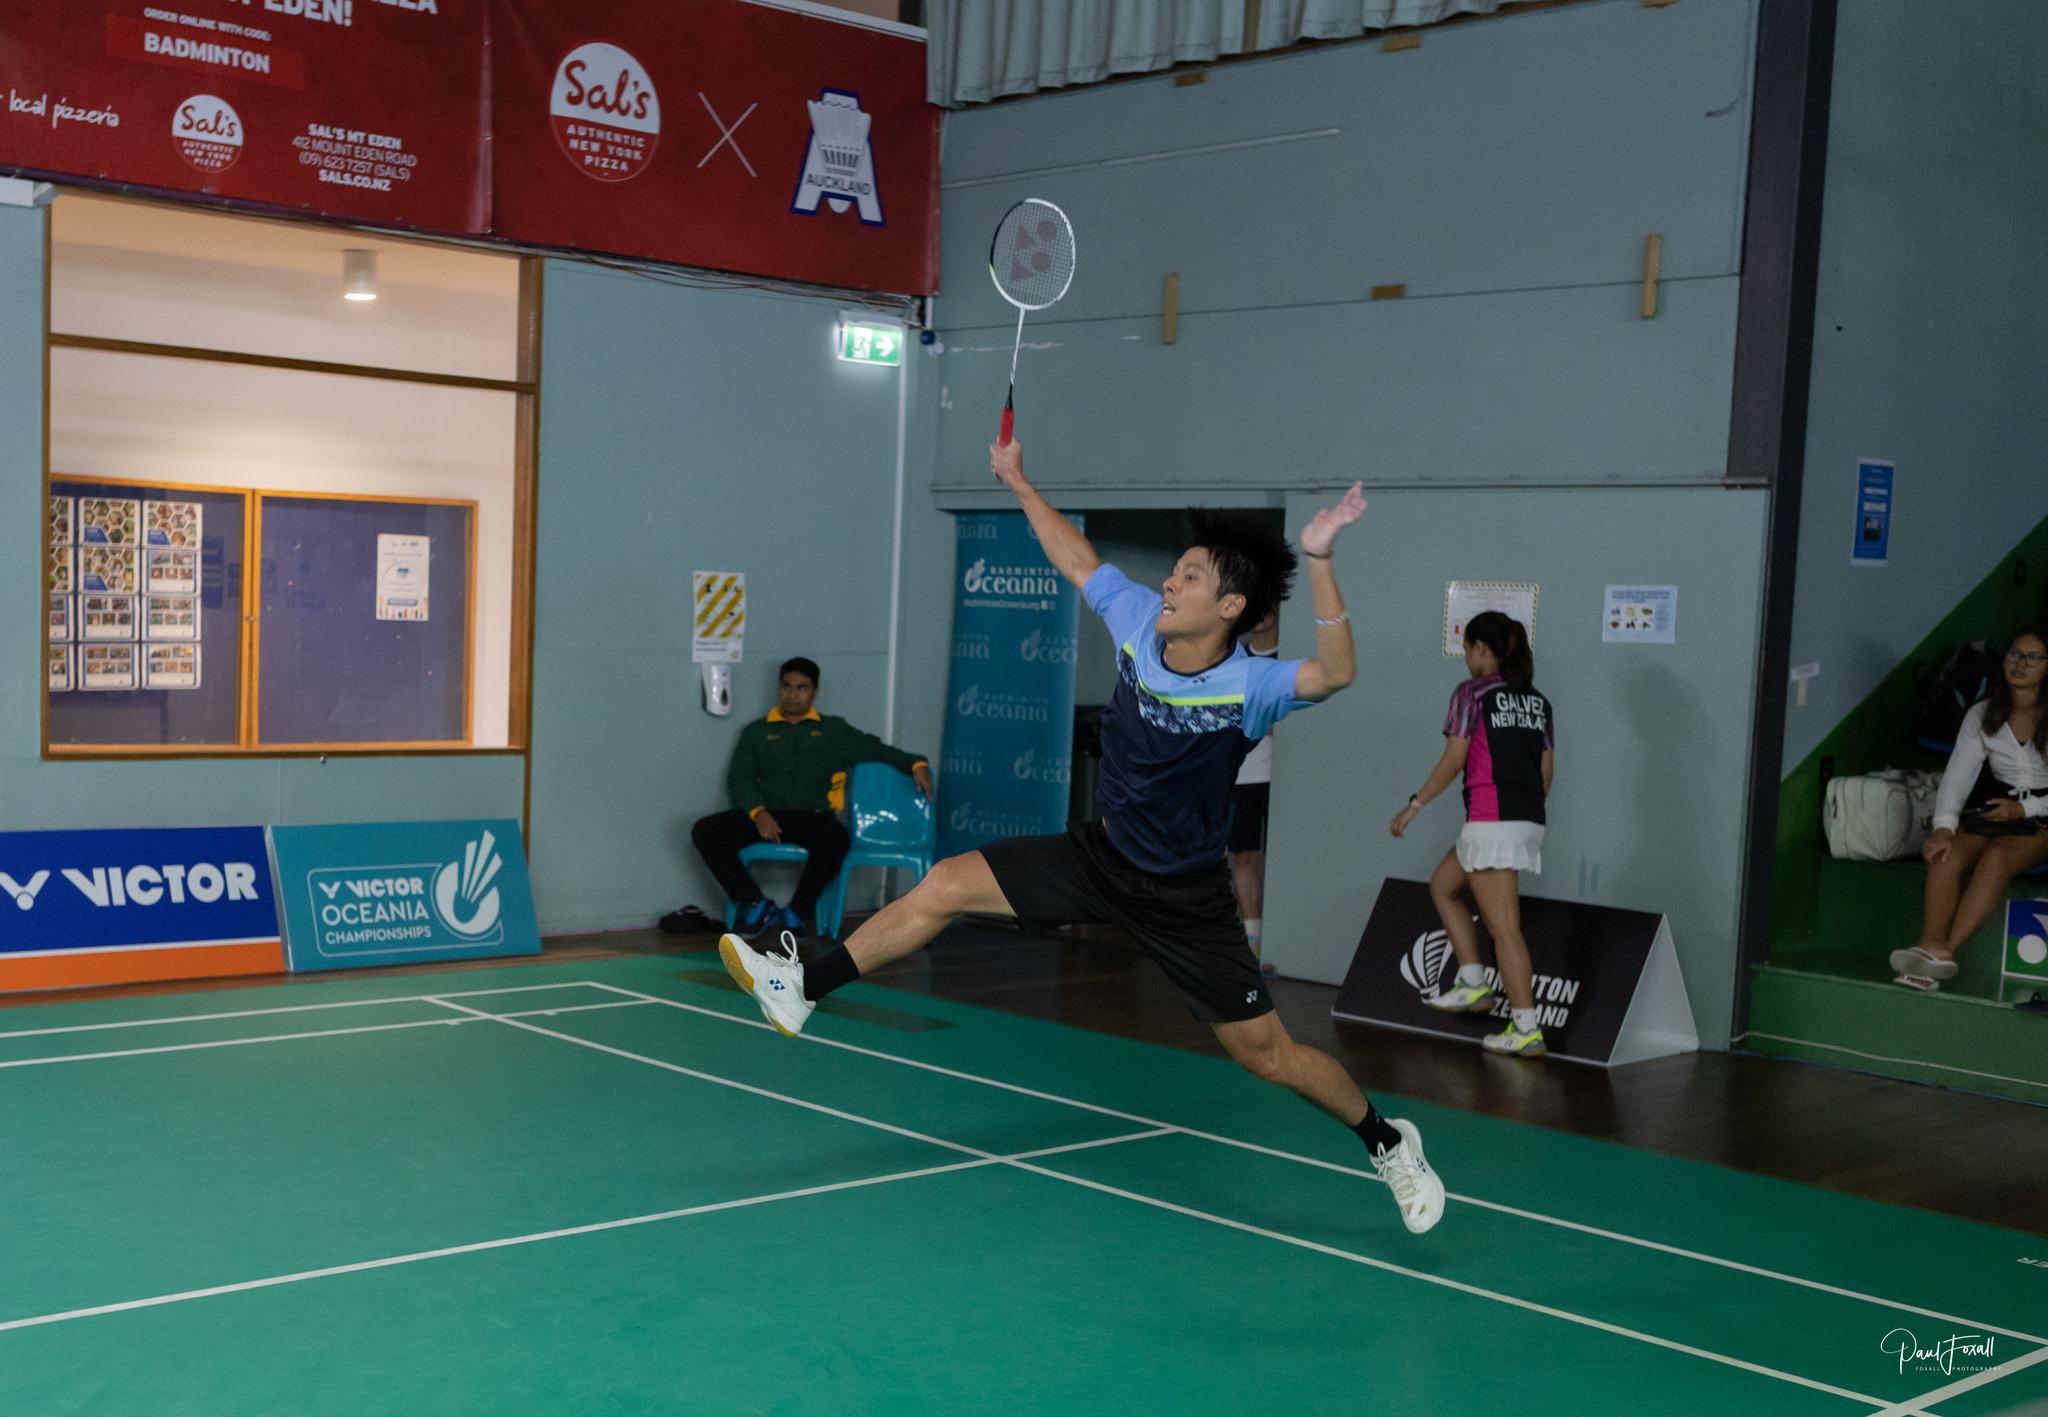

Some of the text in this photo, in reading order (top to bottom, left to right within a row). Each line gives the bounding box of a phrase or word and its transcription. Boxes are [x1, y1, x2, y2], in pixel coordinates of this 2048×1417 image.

[217, 21, 243, 35] WITH
[144, 32, 270, 73] BADMINTON
[565, 60, 650, 119] Sal's
[9, 88, 120, 129] local pizzeria
[181, 104, 237, 137] Sal's
[308, 123, 402, 150] SAL'S MT EDEN
[566, 124, 645, 147] AUTHENTIC
[311, 139, 353, 156] MOUNT
[353, 145, 384, 162] EDEN
[385, 151, 418, 167] ROAD
[569, 138, 643, 160] NEW YORK
[298, 151, 323, 167] (09)
[323, 155, 346, 170] 623
[373, 164, 411, 181] (SALS)
[584, 155, 629, 171] PIZZA
[318, 168, 392, 192] SALS.CO.NZ
[807, 174, 871, 195] AUCKLAND
[964, 560, 1058, 595] Oceania
[989, 566, 1059, 576] BADMINTON
[1491, 712, 1516, 728] NEW
[61, 862, 259, 907] VICTOR
[345, 877, 424, 898] VICTOR
[322, 899, 430, 926] OCEANIA
[325, 925, 432, 945] CHAMPIONSHIPS
